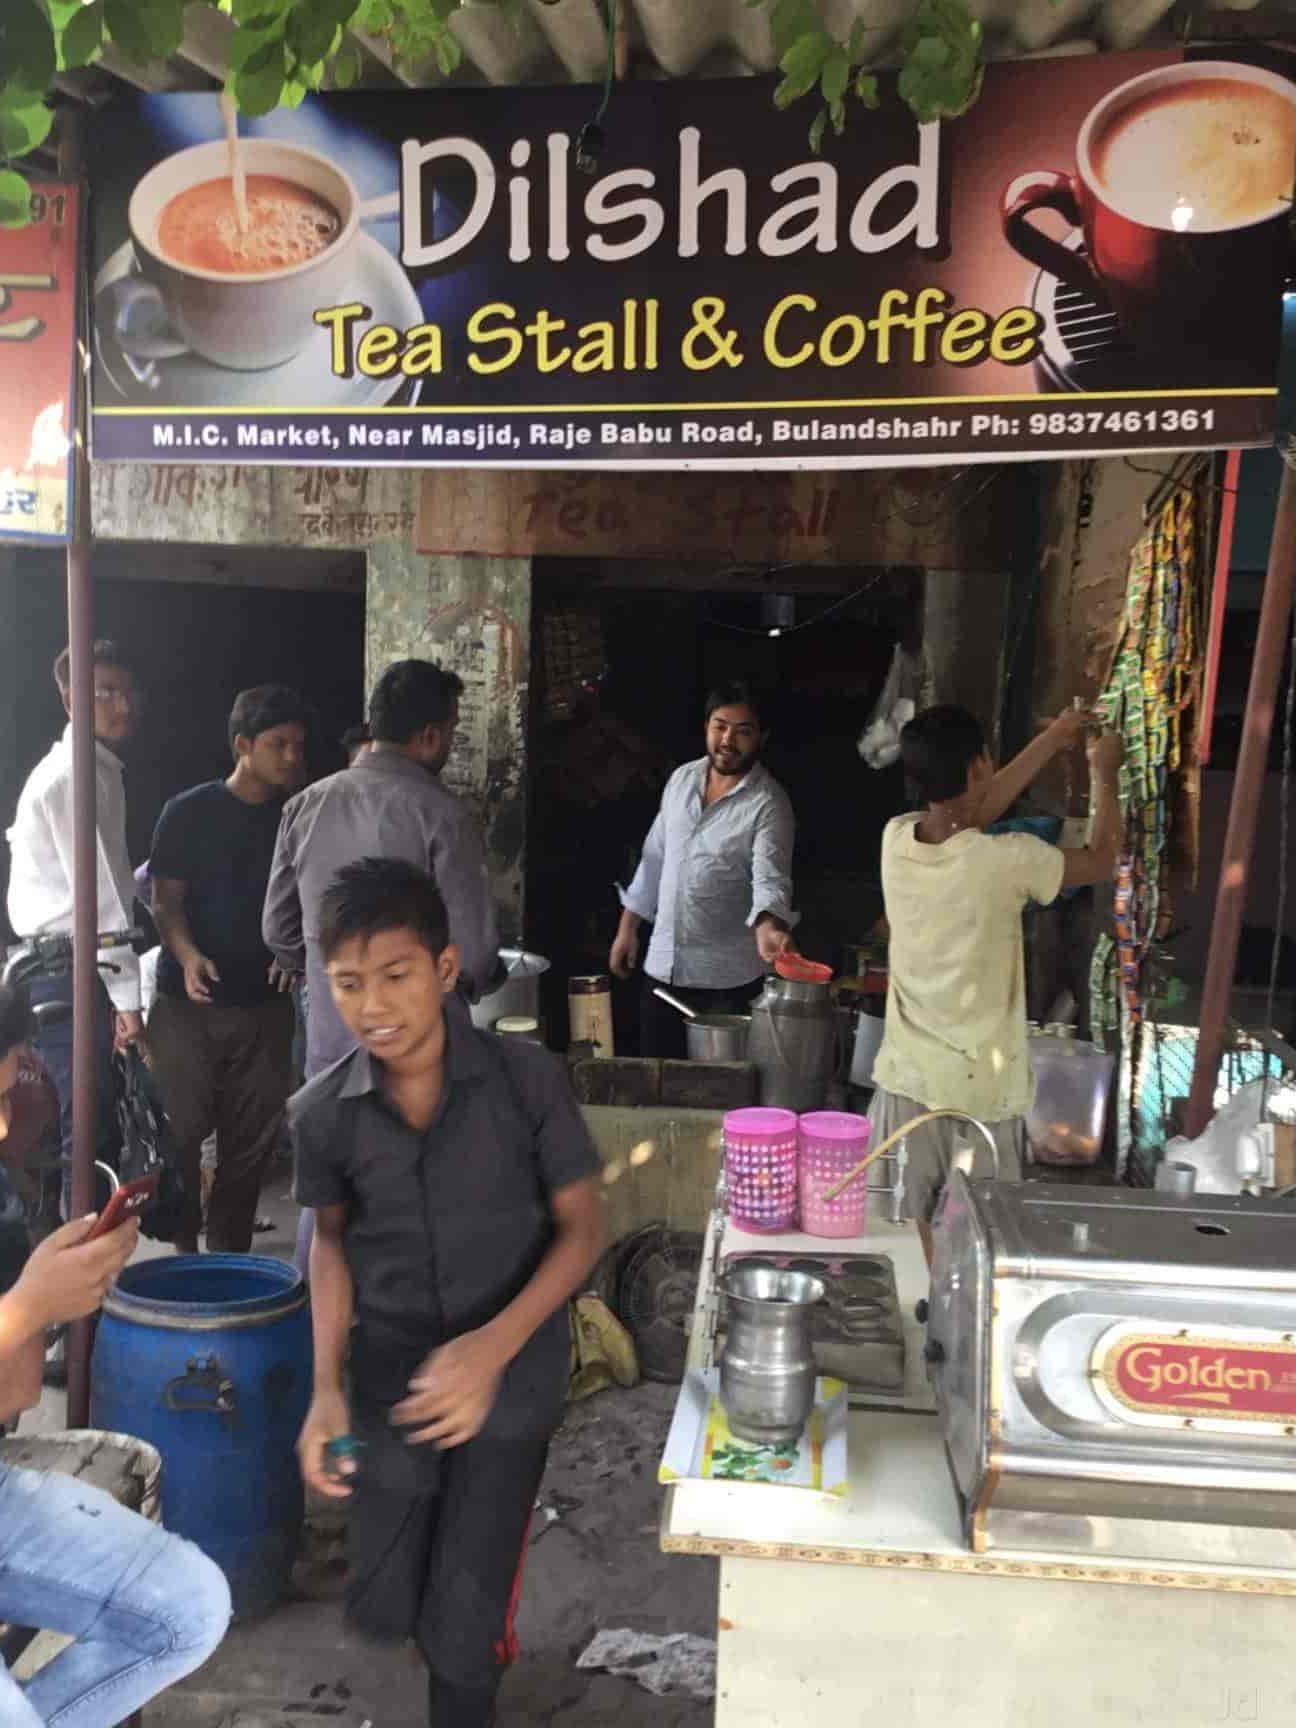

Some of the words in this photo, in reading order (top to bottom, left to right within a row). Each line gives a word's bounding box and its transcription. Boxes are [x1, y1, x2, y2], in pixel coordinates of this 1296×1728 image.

[400, 121, 940, 269] Dilshad
[314, 302, 443, 378] Tea
[466, 299, 658, 376] Stall
[681, 296, 744, 371] &
[763, 288, 1040, 367] Coffee
[152, 424, 228, 447] M.I.C.
[237, 424, 340, 450] Market,
[348, 424, 414, 447] Near
[422, 423, 521, 450] Masjid,
[528, 423, 592, 449] Raje
[600, 421, 672, 445] Babu
[681, 420, 763, 446] Road,
[772, 416, 962, 442] Bulandshahr
[971, 414, 1021, 437] Ph:
[1028, 409, 1216, 435] 9837461361
[1125, 1346, 1272, 1393] Golden
